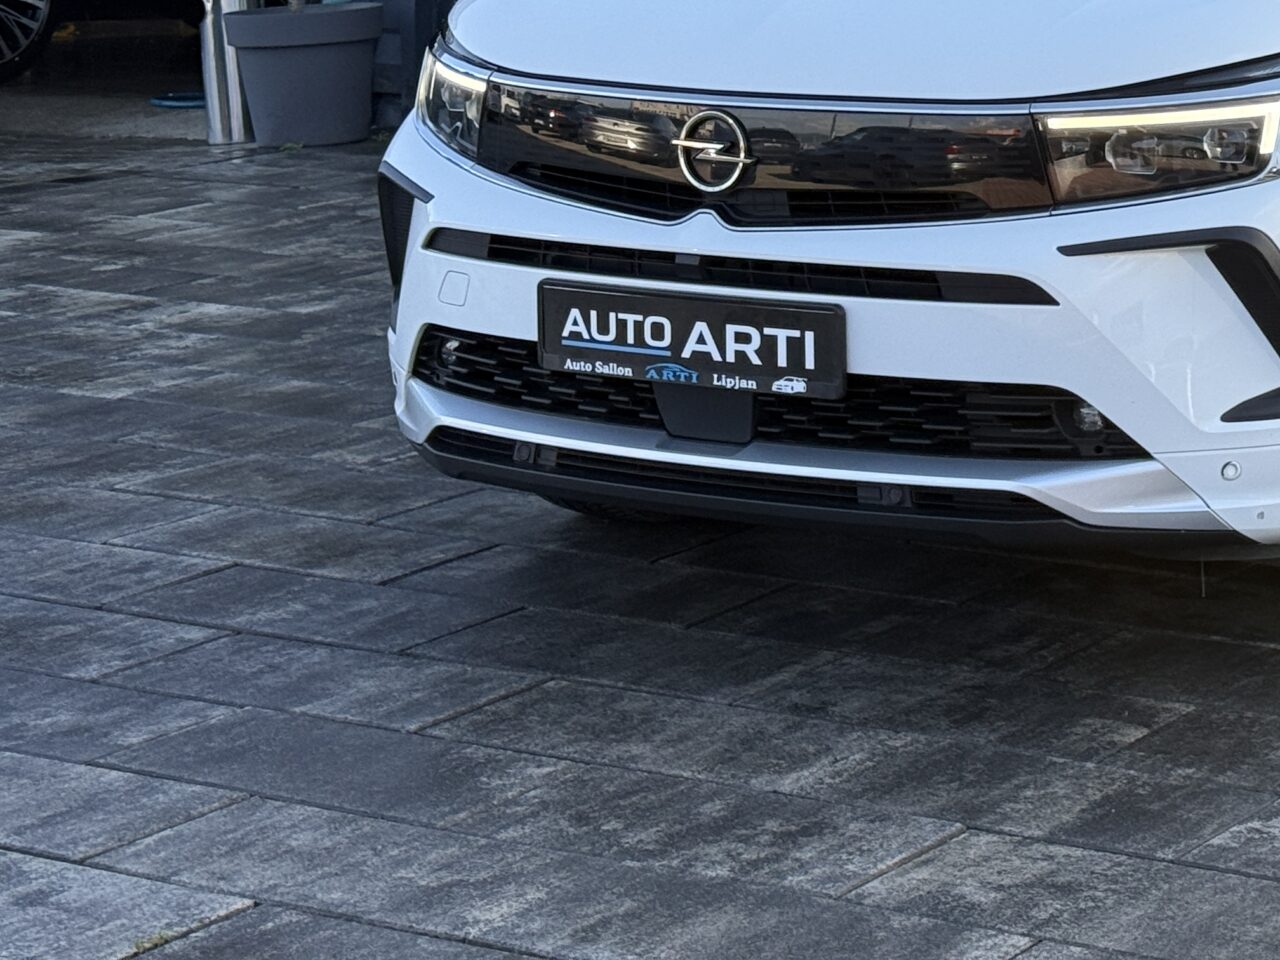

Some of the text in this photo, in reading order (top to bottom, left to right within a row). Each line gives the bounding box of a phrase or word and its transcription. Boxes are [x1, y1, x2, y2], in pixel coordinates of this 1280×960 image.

[561, 307, 815, 370] AUTO ARTI
[564, 358, 757, 390] Auto Sallon ARTI Lipjan
